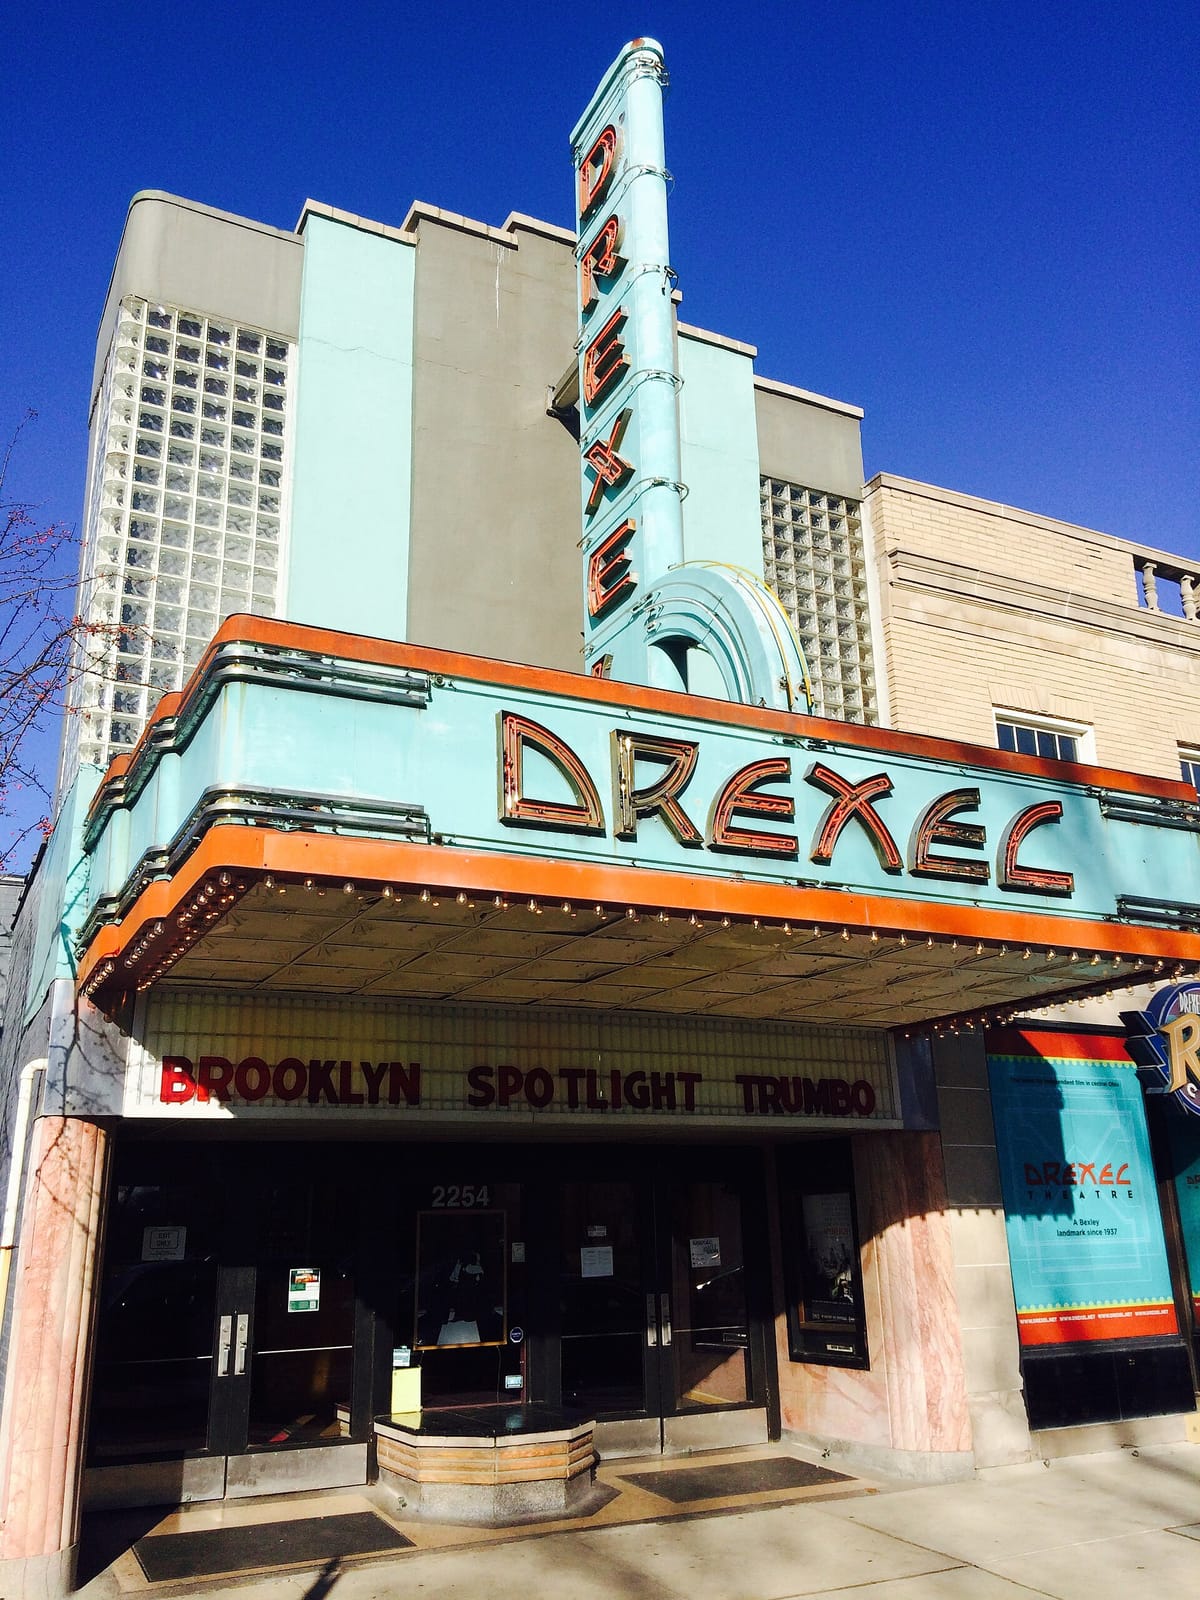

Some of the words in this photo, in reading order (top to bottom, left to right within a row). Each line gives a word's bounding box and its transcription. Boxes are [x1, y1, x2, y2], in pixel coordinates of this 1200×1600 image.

[497, 710, 1074, 895] DREXEL
[159, 1056, 421, 1105] BROOKLYN
[467, 1066, 702, 1111] SPOTLIGHT
[736, 1074, 876, 1115] TRUMBO
[1024, 1162, 1131, 1185] DREXEL
[431, 1185, 490, 1208] 2254
[1028, 1190, 1134, 1199] THEATRE
[1057, 1229, 1086, 1237] landmark
[1104, 1228, 1118, 1236] 1937
